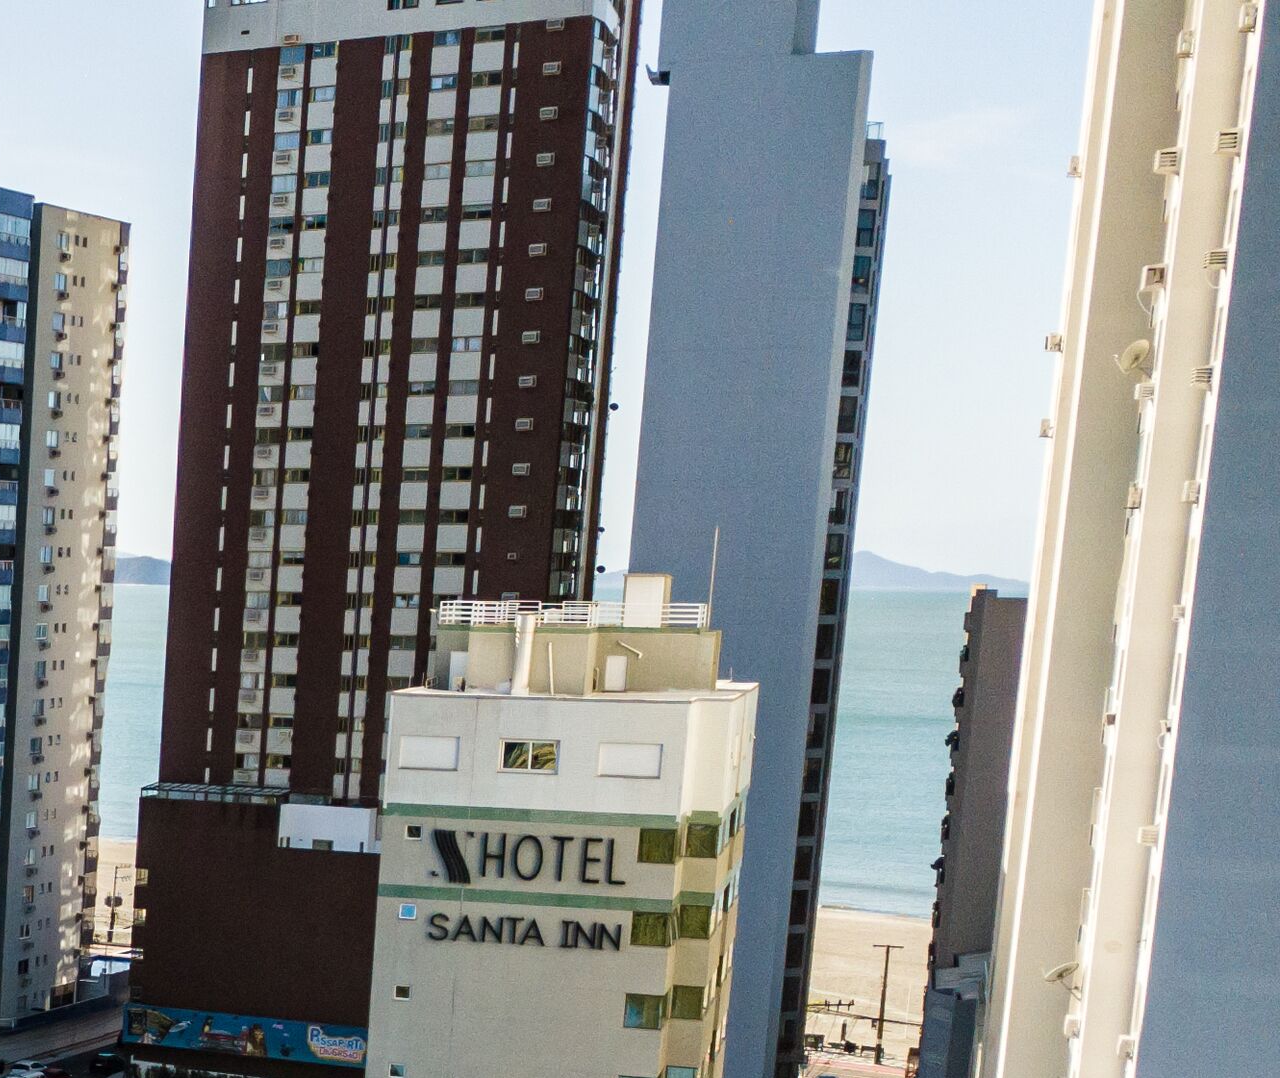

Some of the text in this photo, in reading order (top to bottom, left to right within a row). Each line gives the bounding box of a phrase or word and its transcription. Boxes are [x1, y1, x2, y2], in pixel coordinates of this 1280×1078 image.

[481, 832, 626, 885] HOTEL
[428, 912, 622, 951] SANTA INN
